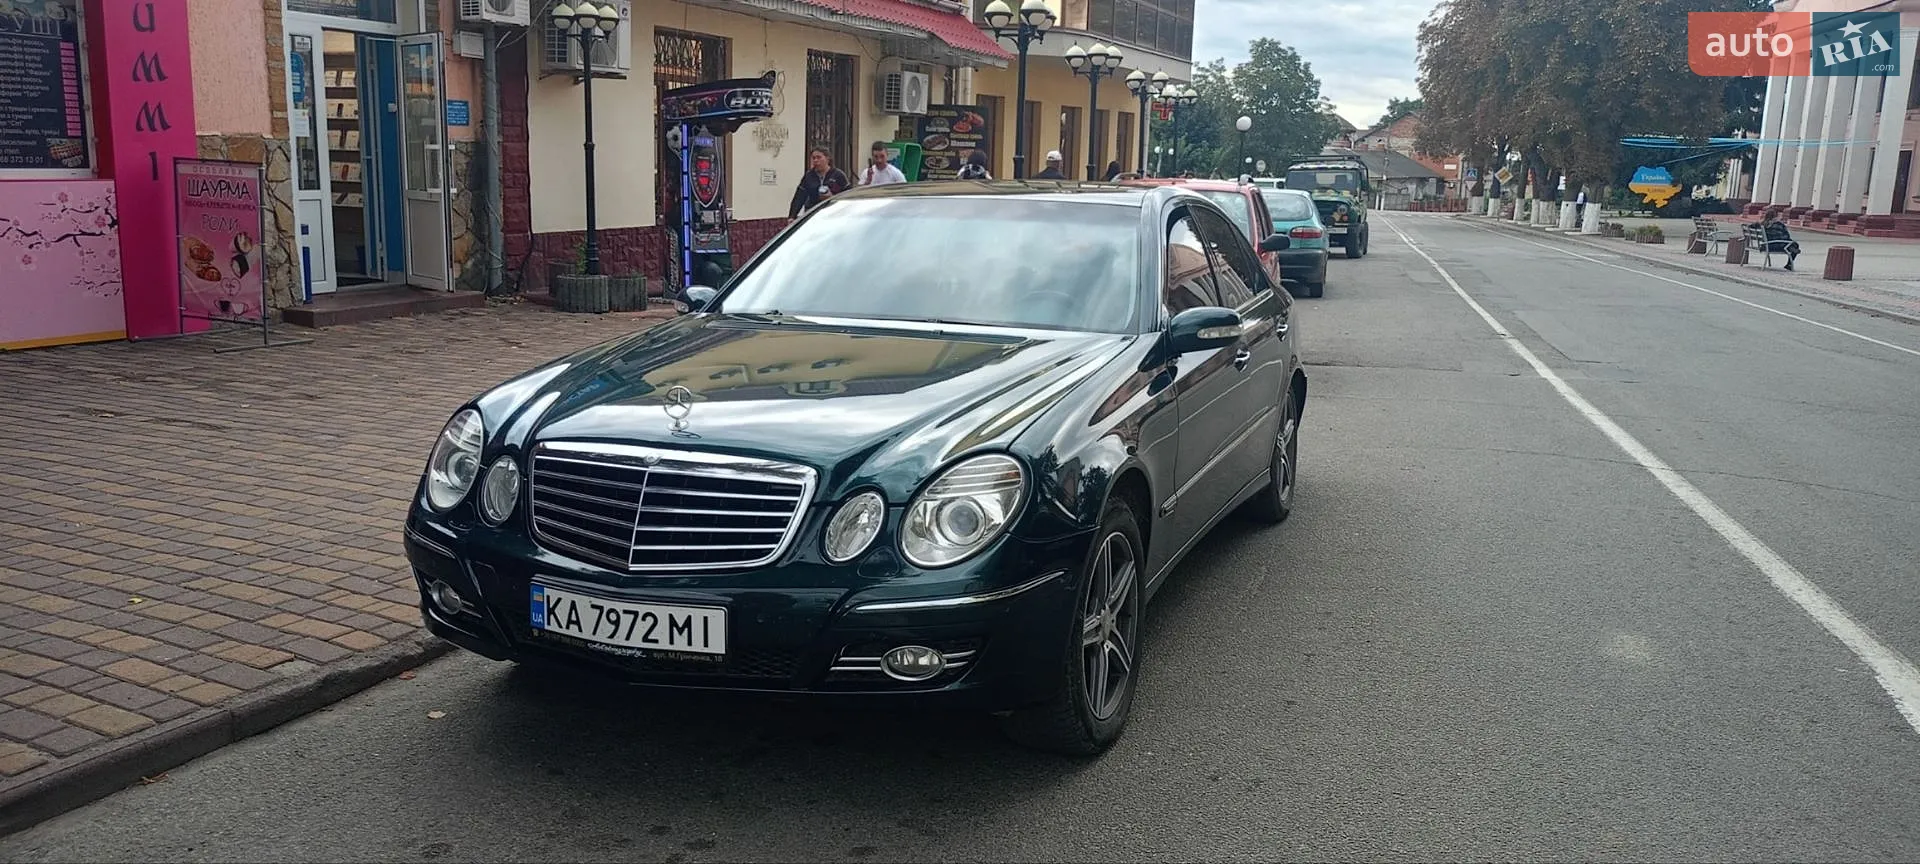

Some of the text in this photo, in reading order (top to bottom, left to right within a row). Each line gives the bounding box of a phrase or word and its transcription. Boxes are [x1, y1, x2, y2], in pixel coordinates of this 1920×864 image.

[187, 178, 253, 201] ШАУРМА
[532, 612, 544, 624] UA
[545, 594, 584, 634] KA
[589, 603, 659, 645] 7972
[668, 613, 710, 649] MI
